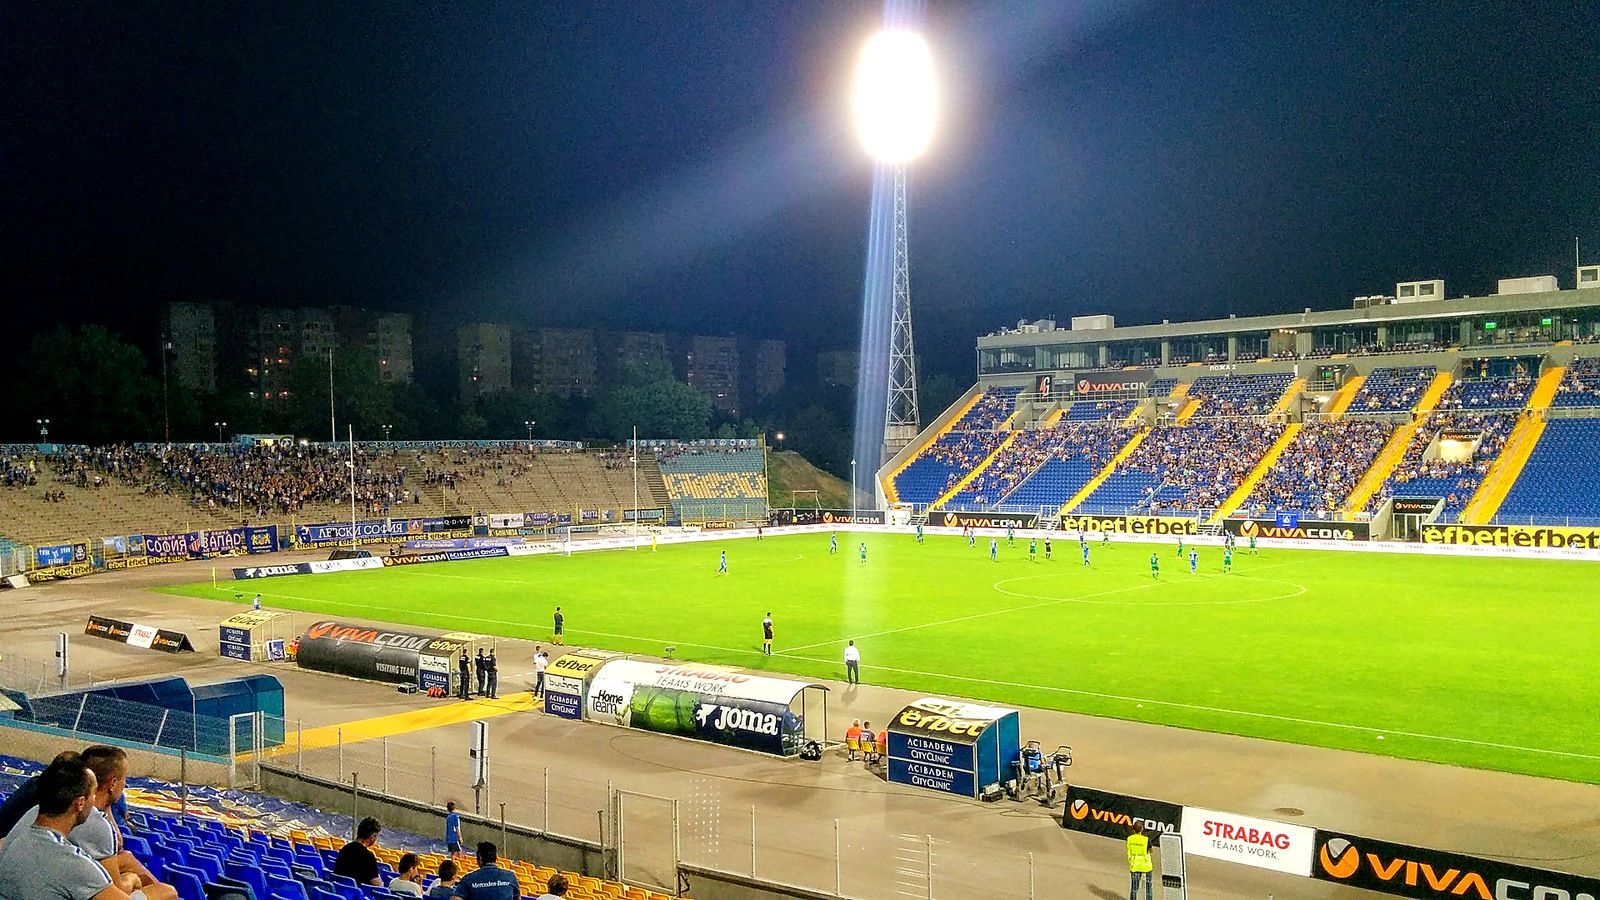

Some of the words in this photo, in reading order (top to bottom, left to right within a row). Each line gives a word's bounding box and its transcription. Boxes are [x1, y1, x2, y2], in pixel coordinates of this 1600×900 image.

[834, 515, 880, 524] VIVACOM
[960, 518, 1023, 528] VIVACOM
[1064, 516, 1126, 533] efbet
[1130, 518, 1192, 535] efbet
[147, 539, 188, 553] СОФИЯ
[1423, 525, 1508, 546] efbet
[1512, 528, 1599, 550] efbet
[393, 552, 447, 565] VIVACOM
[328, 627, 431, 650] VIVACOM
[376, 662, 399, 675] VISITING
[400, 665, 416, 677] TEAM
[555, 658, 594, 672] efbet
[656, 676, 690, 689] TEAMS
[693, 681, 727, 693] WORK
[549, 694, 579, 706] ACIBADEM
[591, 695, 617, 715] Team
[598, 689, 624, 705] Home
[900, 710, 989, 737] efbet
[906, 737, 954, 754] ACIBADEM
[907, 763, 954, 780] ACIBADEM
[1203, 820, 1291, 850] STRABAG
[1212, 839, 1244, 853] TEAMS
[1366, 853, 1596, 900] VIVACO
